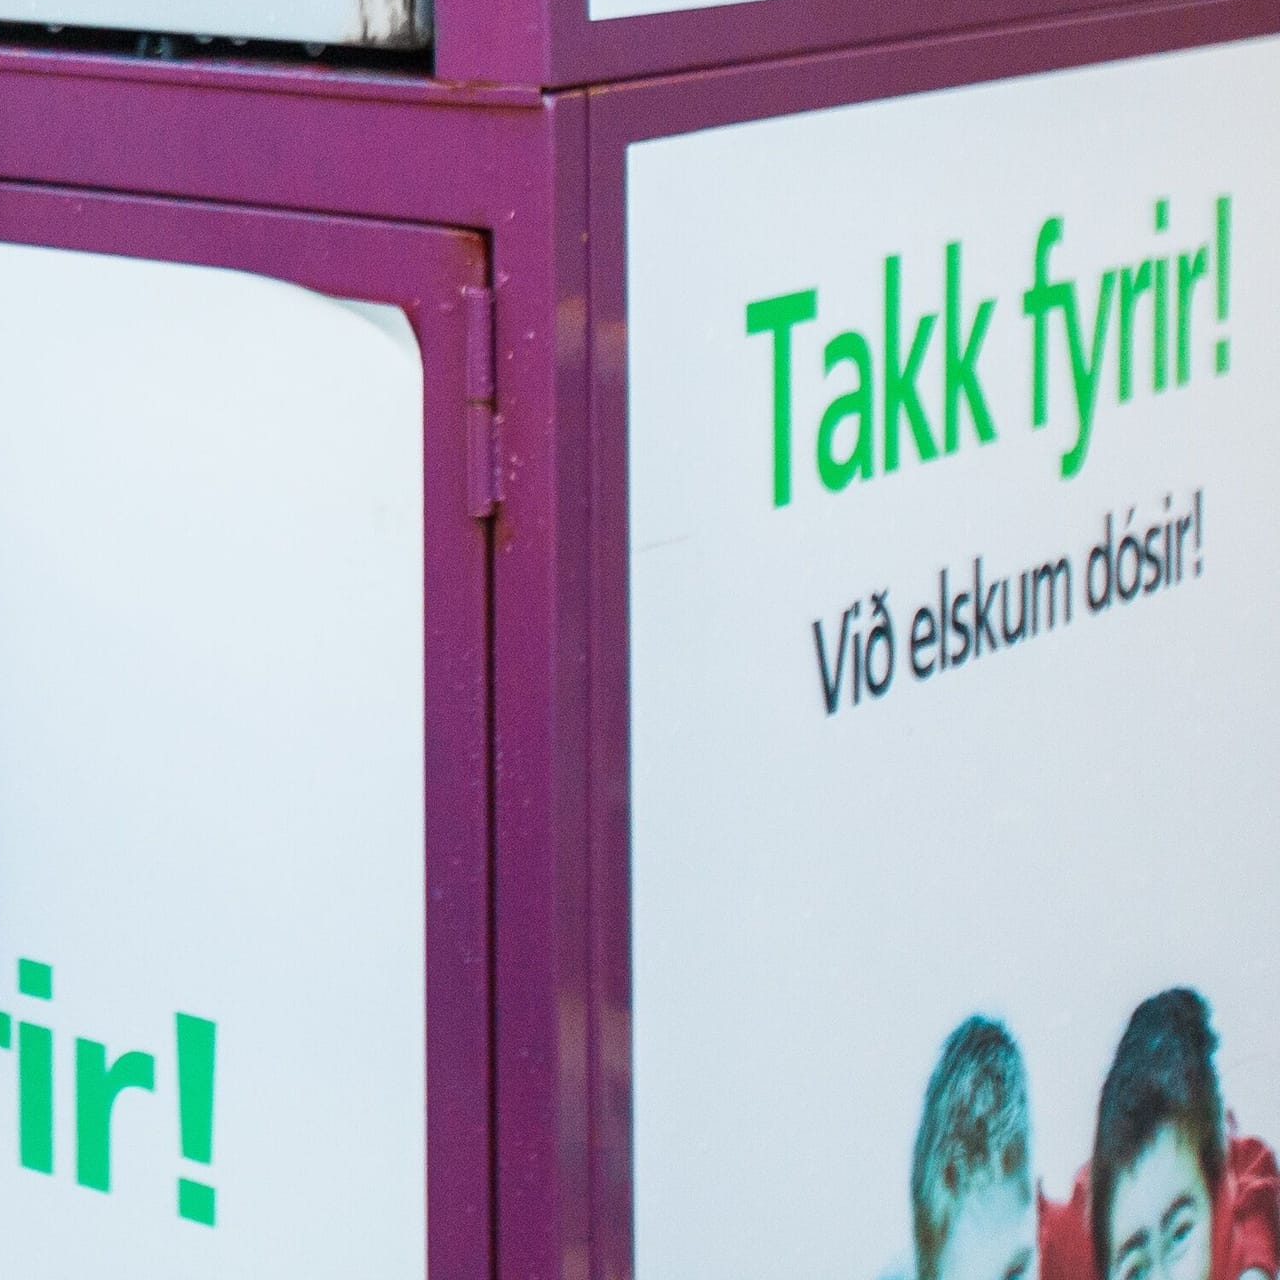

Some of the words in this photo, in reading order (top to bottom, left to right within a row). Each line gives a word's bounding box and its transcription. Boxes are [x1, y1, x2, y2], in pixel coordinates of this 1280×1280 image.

[746, 239, 998, 510] Takk
[1023, 194, 1232, 481] fyrir!
[812, 588, 896, 717] Við
[908, 553, 1073, 682] elskum
[1085, 487, 1204, 614] dósir!
